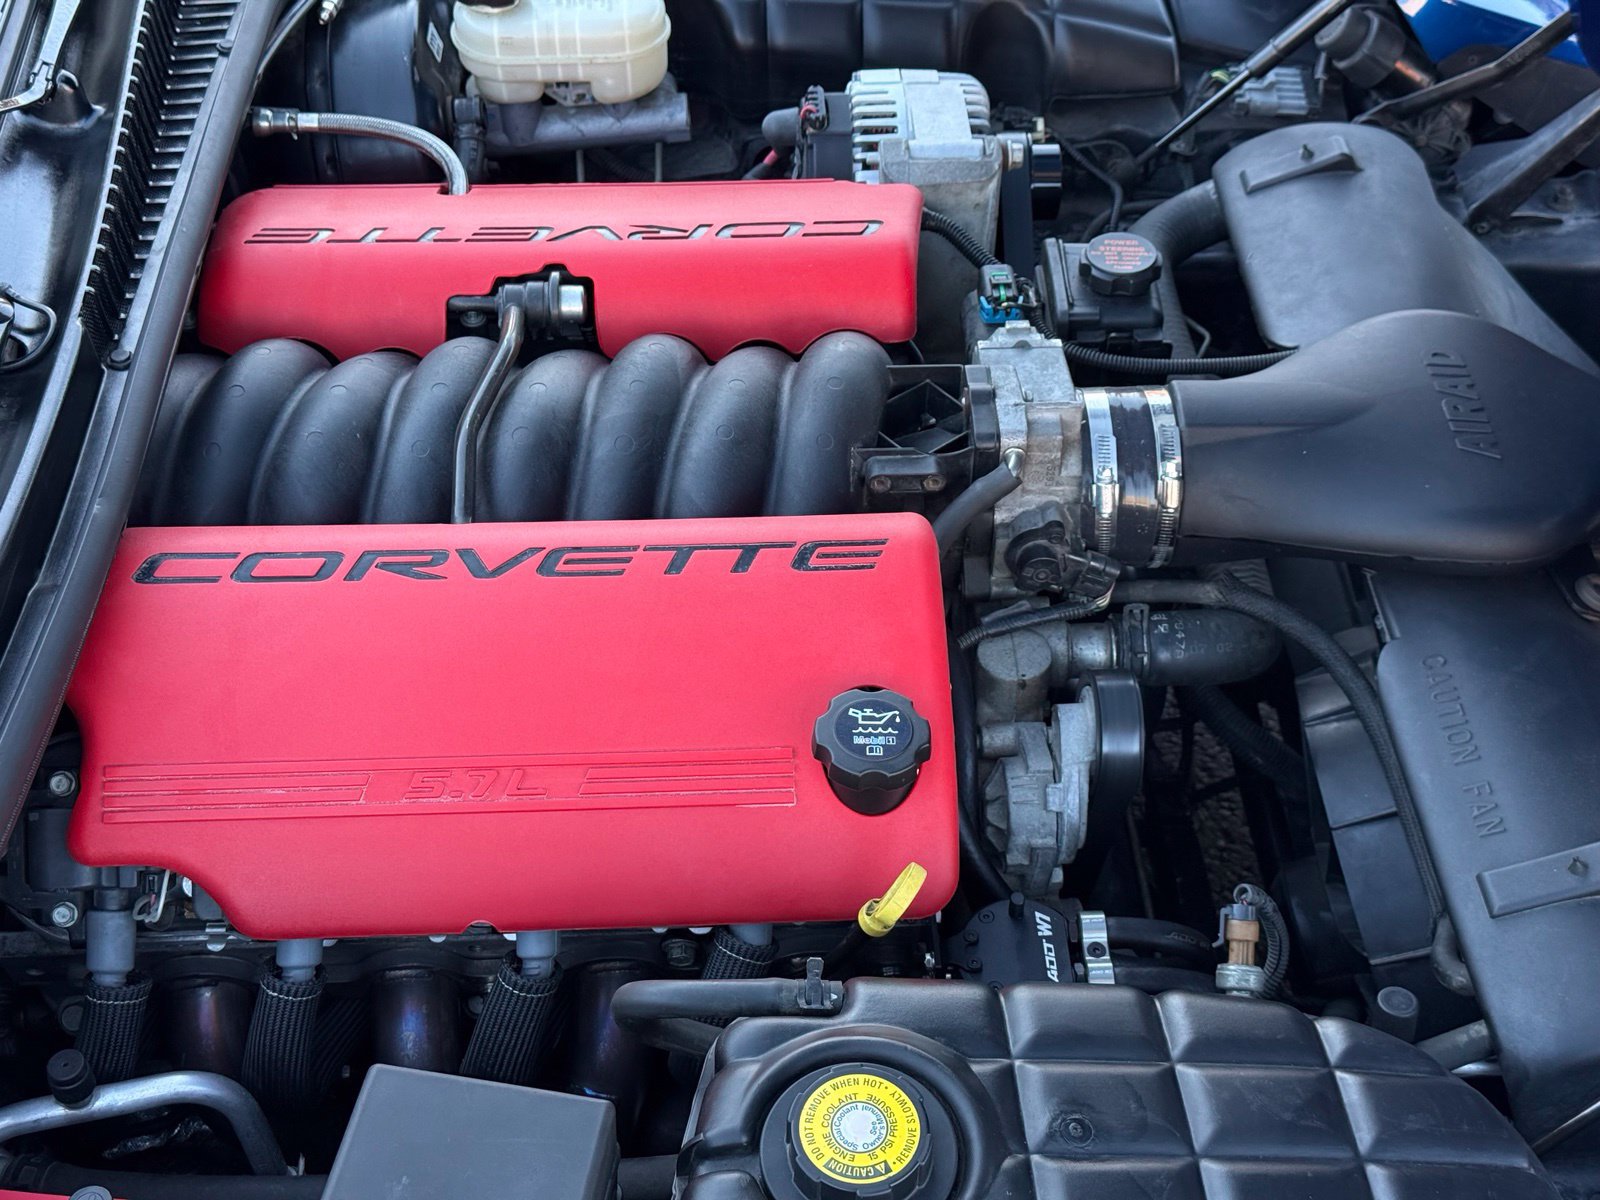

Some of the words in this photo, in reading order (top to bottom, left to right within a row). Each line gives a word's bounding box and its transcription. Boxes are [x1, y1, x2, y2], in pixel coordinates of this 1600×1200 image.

[243, 219, 885, 245] CORVETTE
[1424, 352, 1503, 460] AIRAID
[133, 538, 889, 585] CORVETTE
[853, 735, 885, 745] Mobil
[1422, 653, 1482, 767] CAUTION
[1462, 780, 1508, 838] FAN
[403, 767, 548, 800] 5.7L
[830, 1077, 860, 1091] WHEN
[862, 1077, 884, 1090] HOT
[805, 1088, 831, 1124] REMOVE
[821, 1092, 859, 1128] COOLANT
[833, 1103, 859, 1127] Coolant
[861, 1104, 885, 1125] Manual
[865, 1093, 898, 1138] PRESSURE
[889, 1090, 916, 1124] SLOWLY
[804, 1126, 816, 1146] NOT
[833, 1126, 859, 1151] Special
[862, 1125, 886, 1150] Owner's
[869, 1121, 879, 1136] See
[811, 1146, 825, 1161] DO
[822, 1132, 856, 1163] ENGINE
[868, 1151, 879, 1161] 15
[880, 1137, 895, 1155] PSI
[896, 1126, 917, 1165] REMOVE
[828, 1160, 875, 1177] CAUTION
